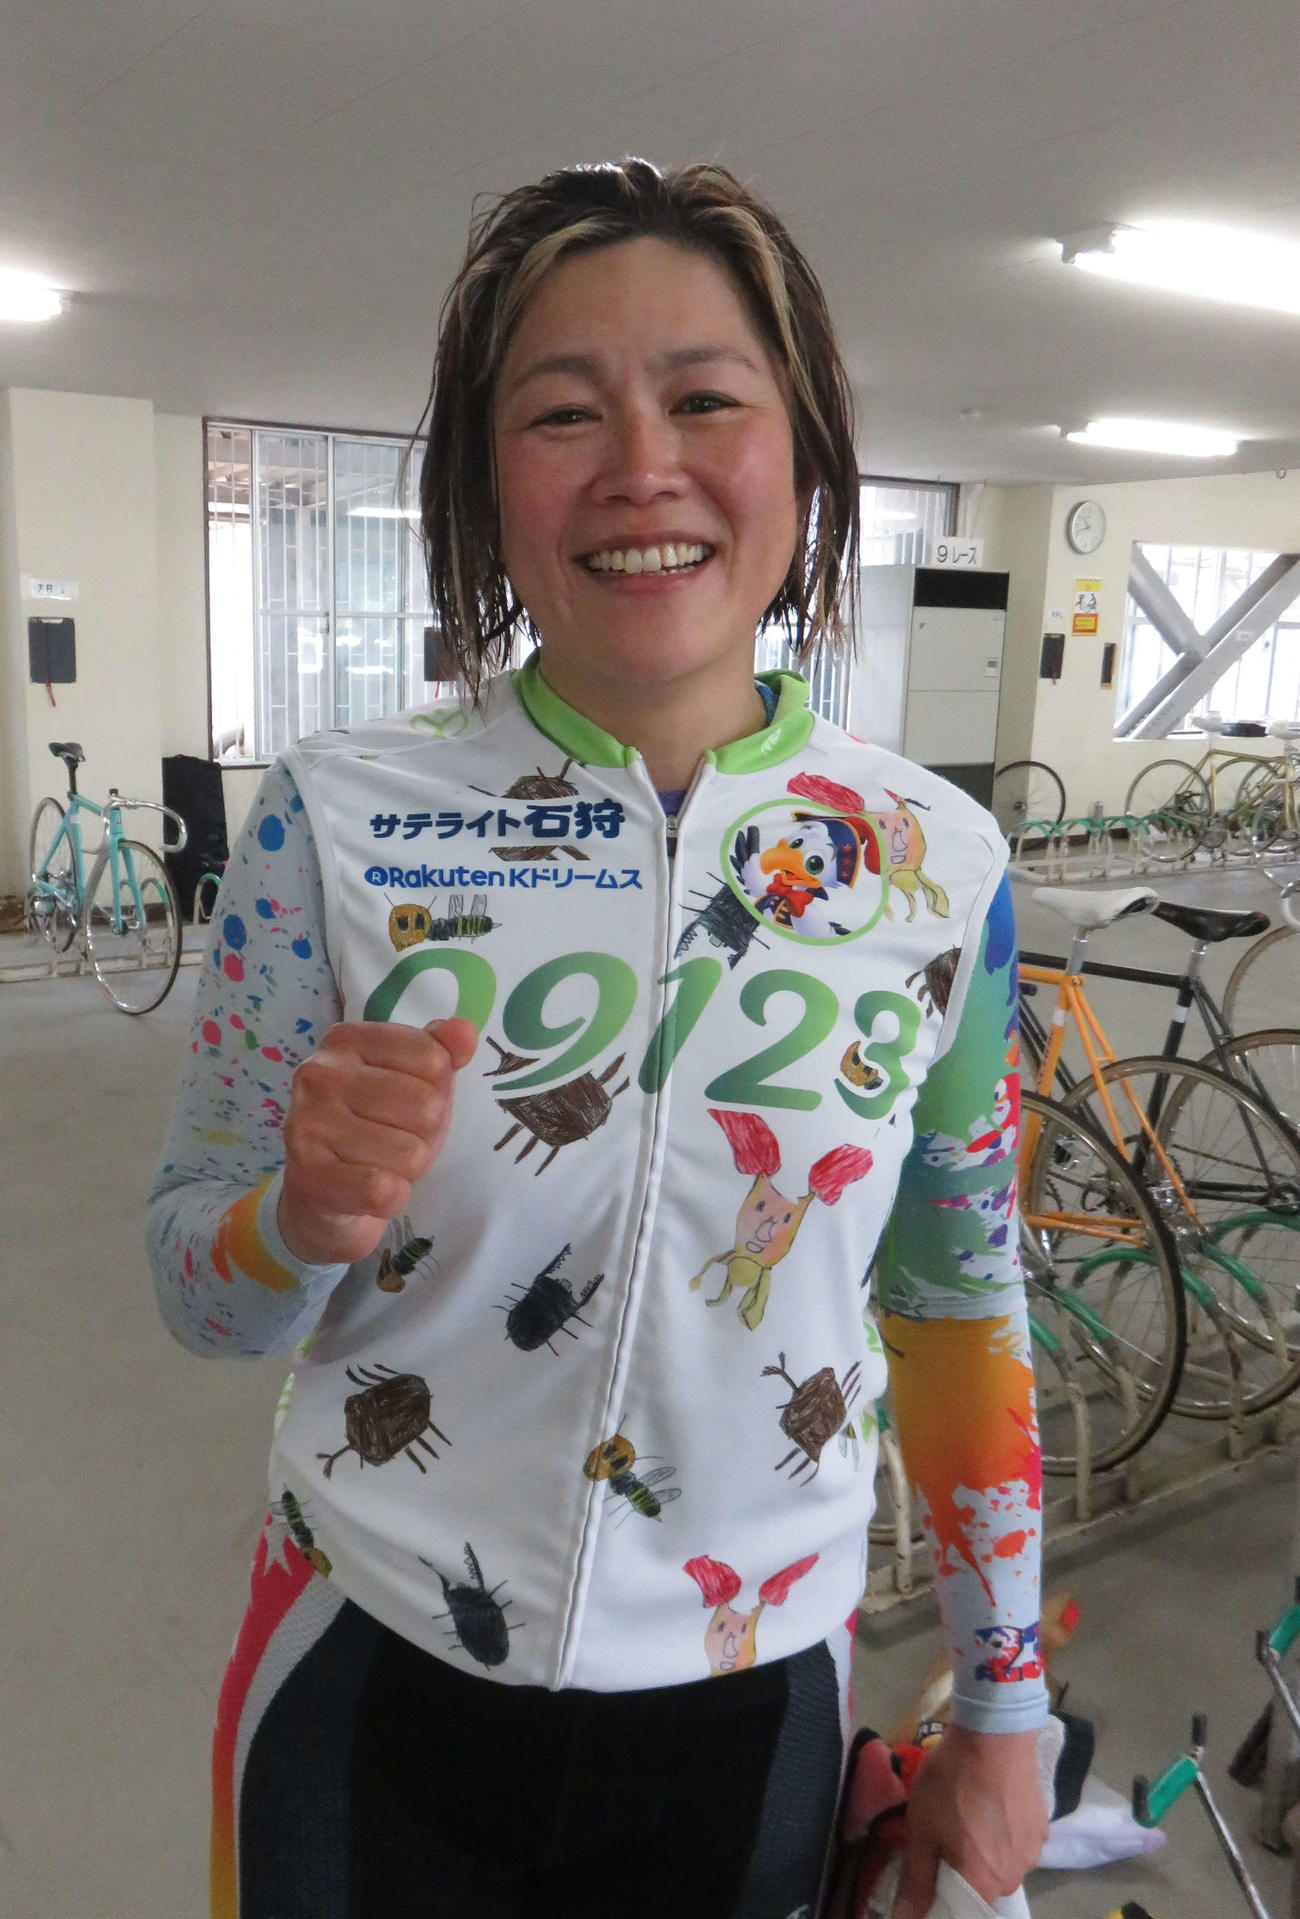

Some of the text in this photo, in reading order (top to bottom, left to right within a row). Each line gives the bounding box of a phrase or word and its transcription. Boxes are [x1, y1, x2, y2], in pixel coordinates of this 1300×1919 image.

[370, 799, 625, 840] サテライト石狩
